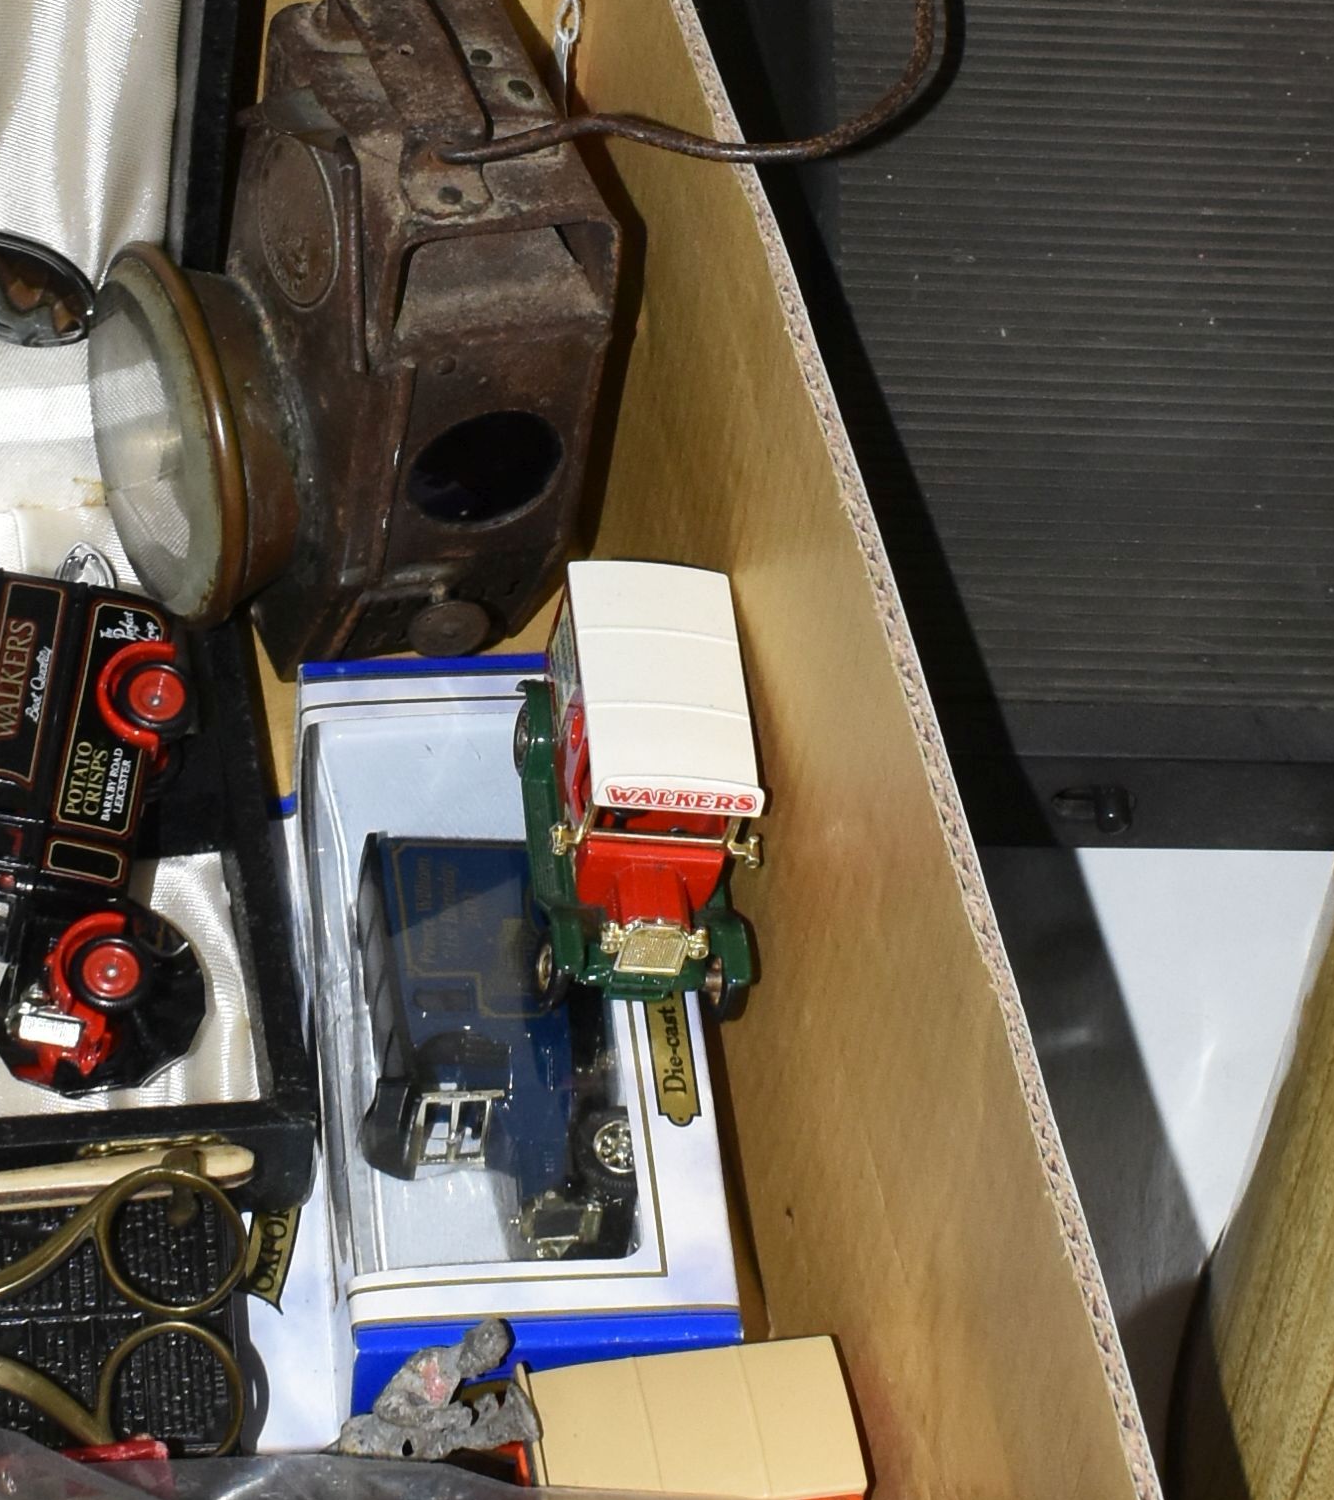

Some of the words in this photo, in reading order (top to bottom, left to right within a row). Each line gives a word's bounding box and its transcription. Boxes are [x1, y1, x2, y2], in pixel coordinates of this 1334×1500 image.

[30, 646, 54, 691] Quality
[25, 690, 44, 723] Best
[64, 741, 94, 815] POTATO
[83, 749, 109, 817] CRISPS
[109, 747, 124, 777] ROAD
[112, 759, 133, 815] LEICESTER
[606, 785, 759, 813] WALKERS
[662, 1004, 687, 1095] Die-cast
